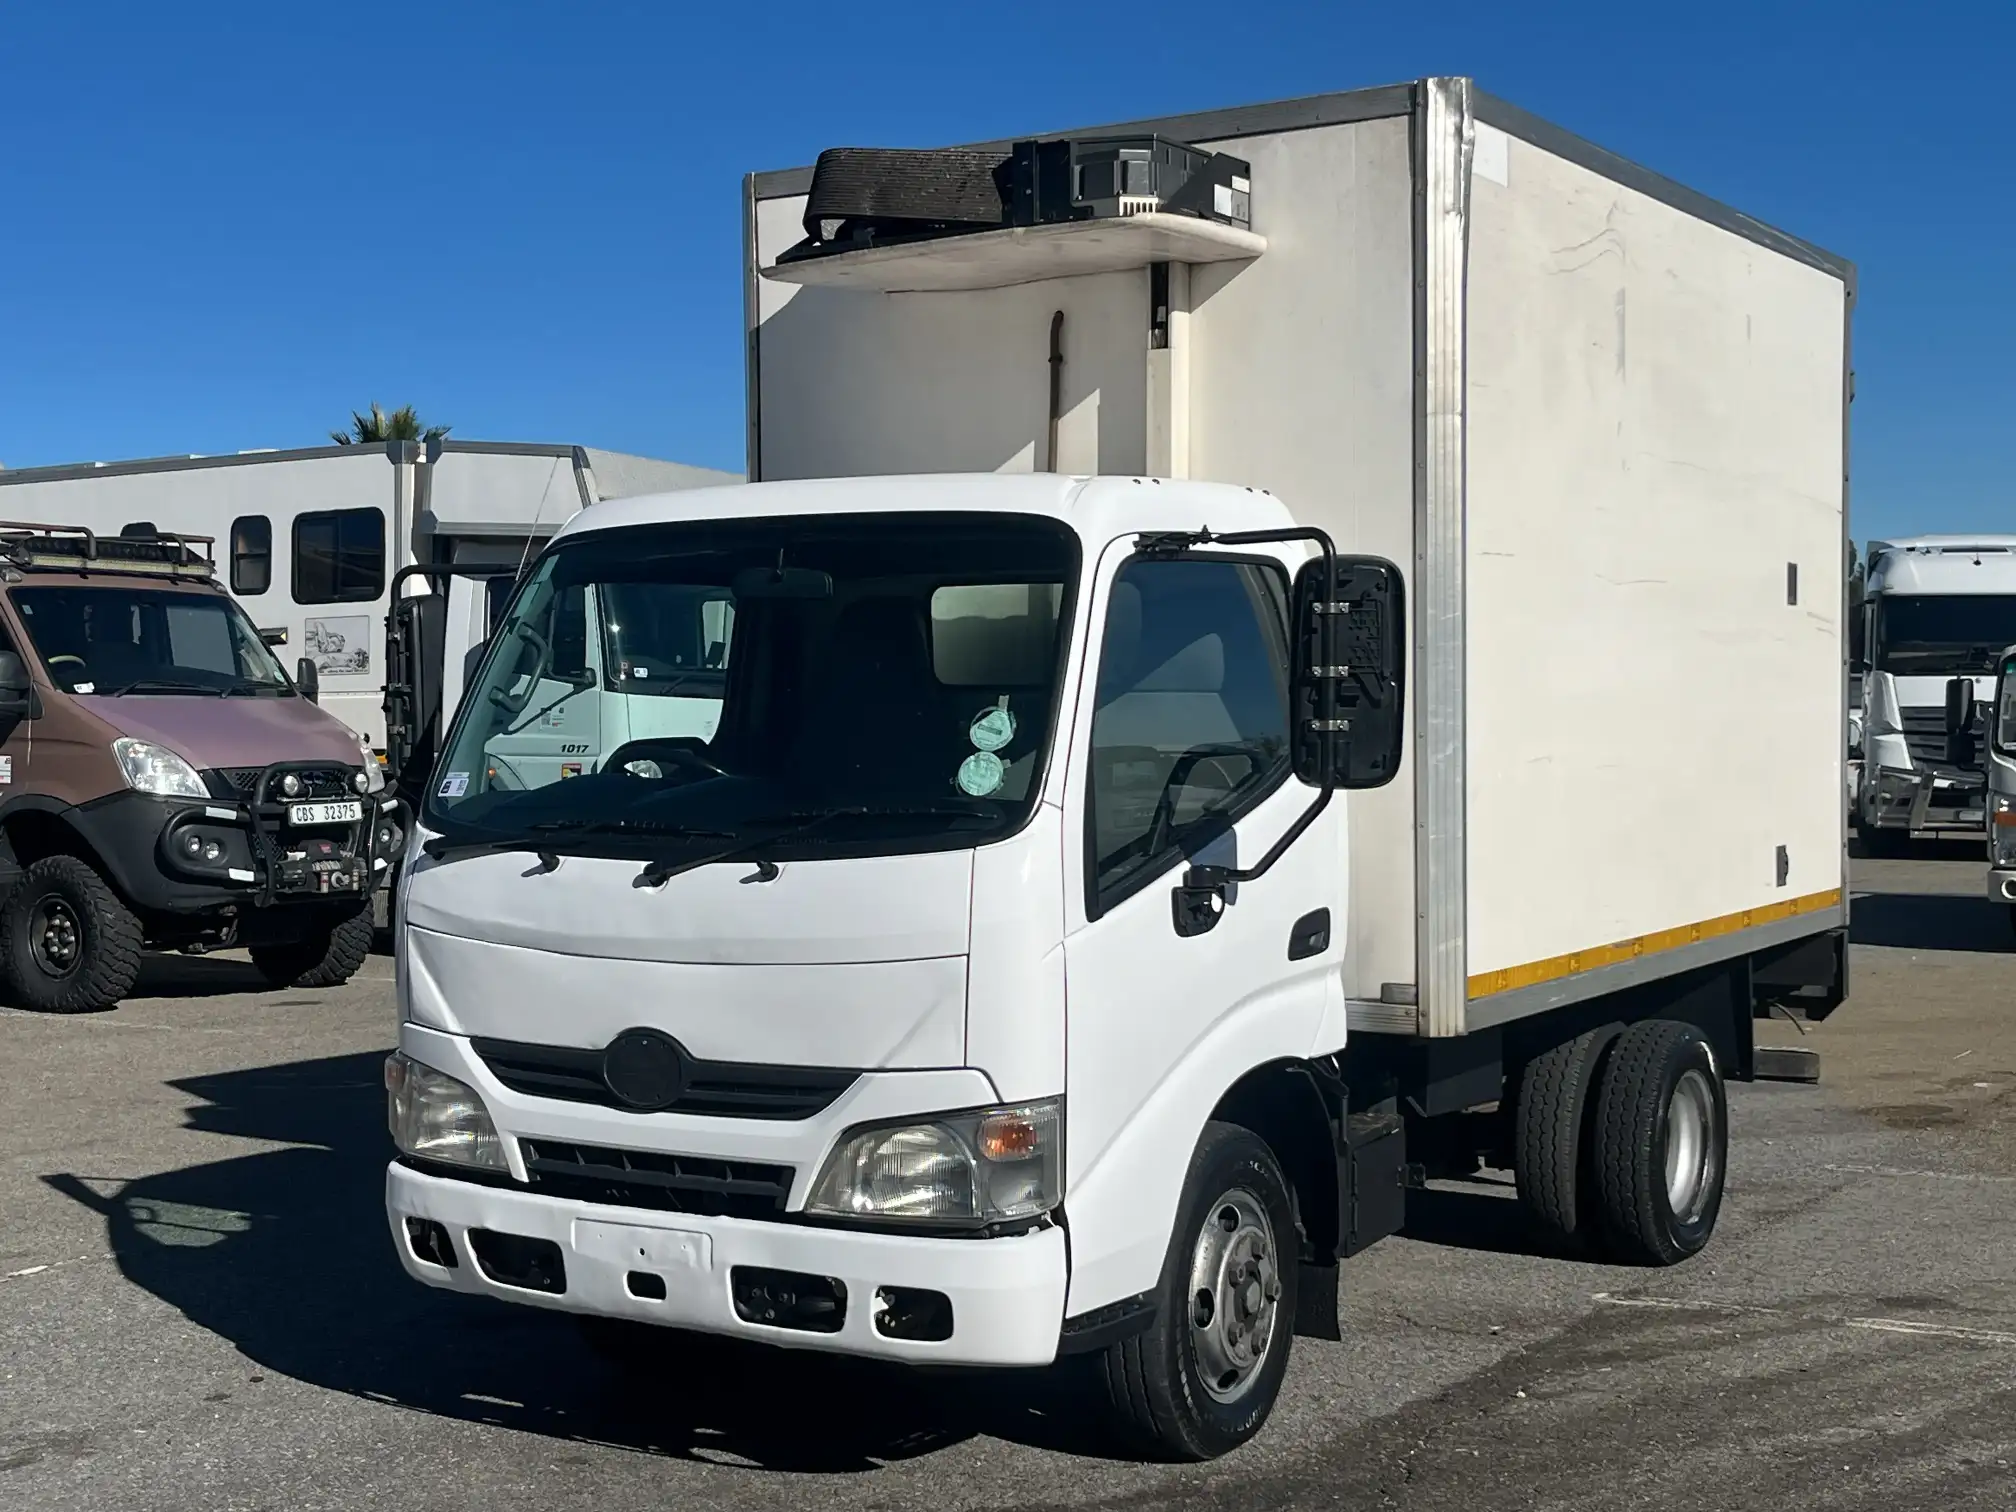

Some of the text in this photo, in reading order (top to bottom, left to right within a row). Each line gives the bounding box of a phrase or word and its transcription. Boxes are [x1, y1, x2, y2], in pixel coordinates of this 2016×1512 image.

[561, 744, 589, 753] 1017
[296, 804, 356, 822] CBS 32375
